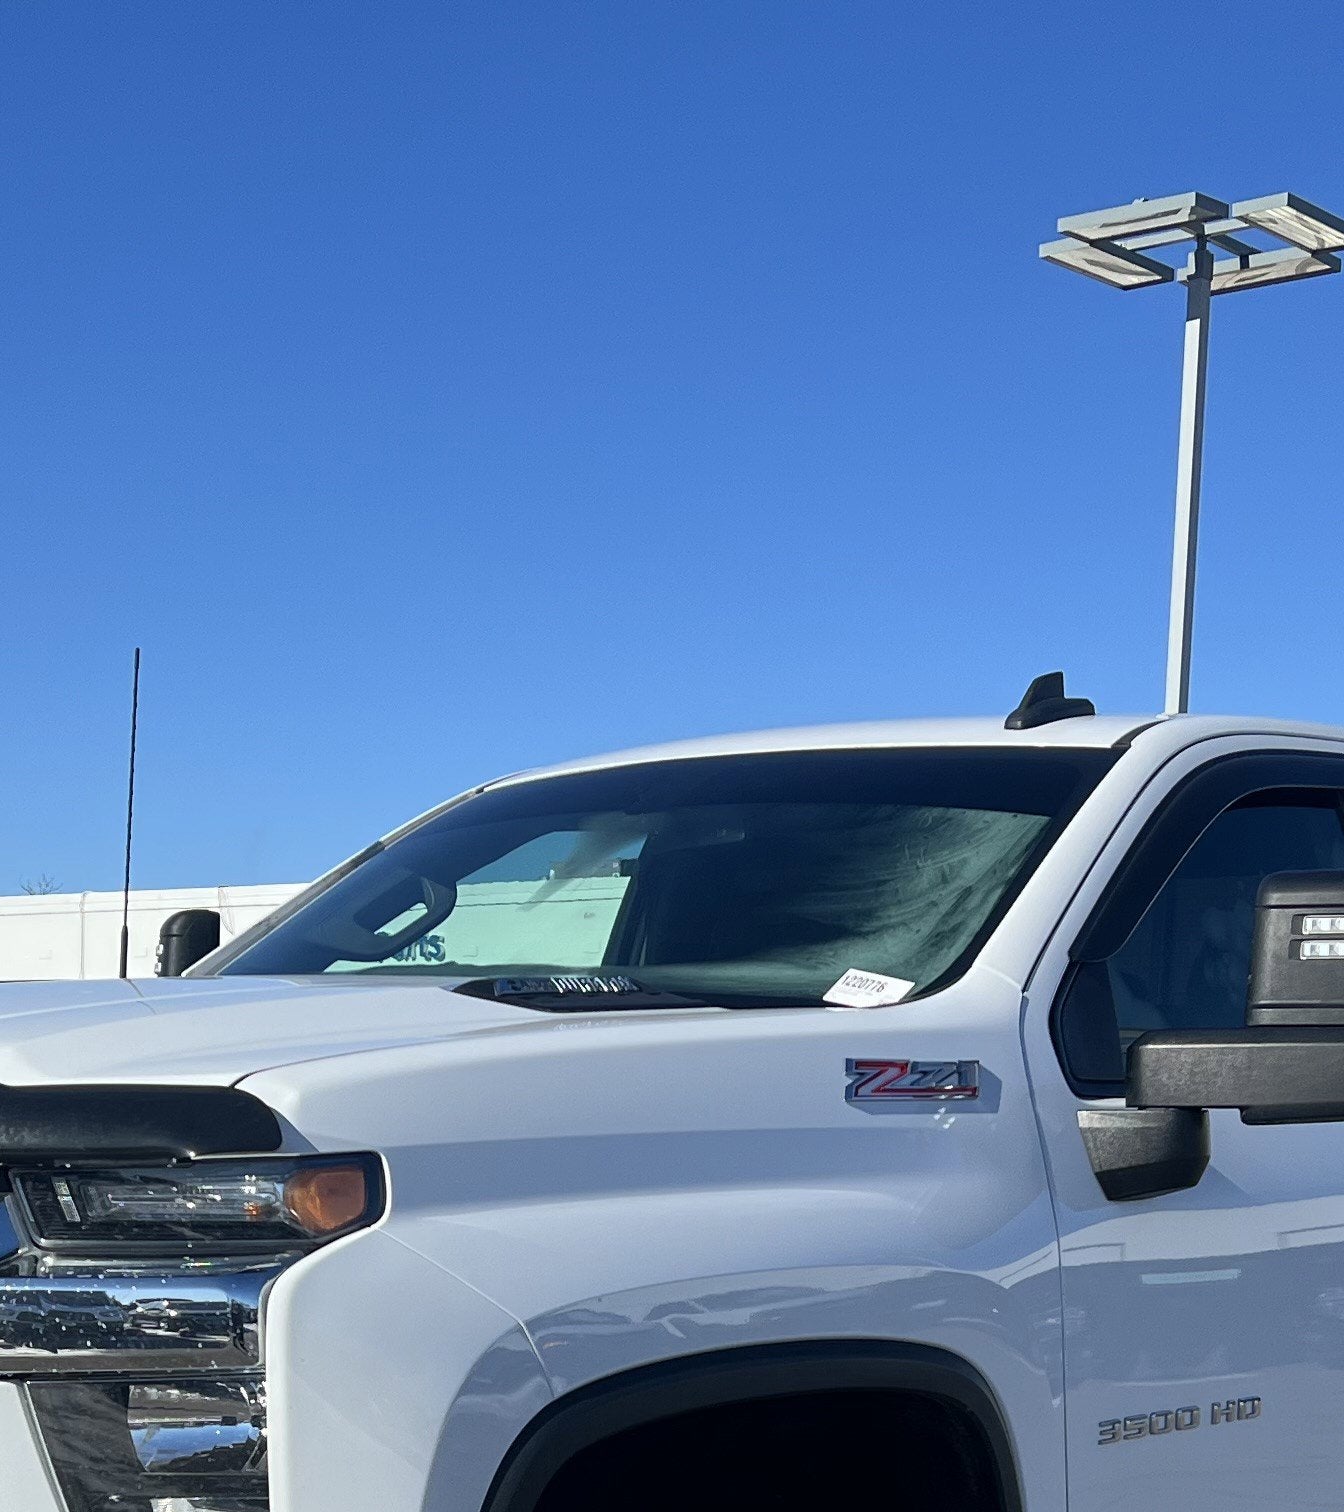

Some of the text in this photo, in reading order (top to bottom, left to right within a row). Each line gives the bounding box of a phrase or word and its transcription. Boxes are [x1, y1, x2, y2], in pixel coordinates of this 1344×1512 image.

[845, 1058, 980, 1102] Z71
[1098, 1396, 1262, 1446] 3500 HD
